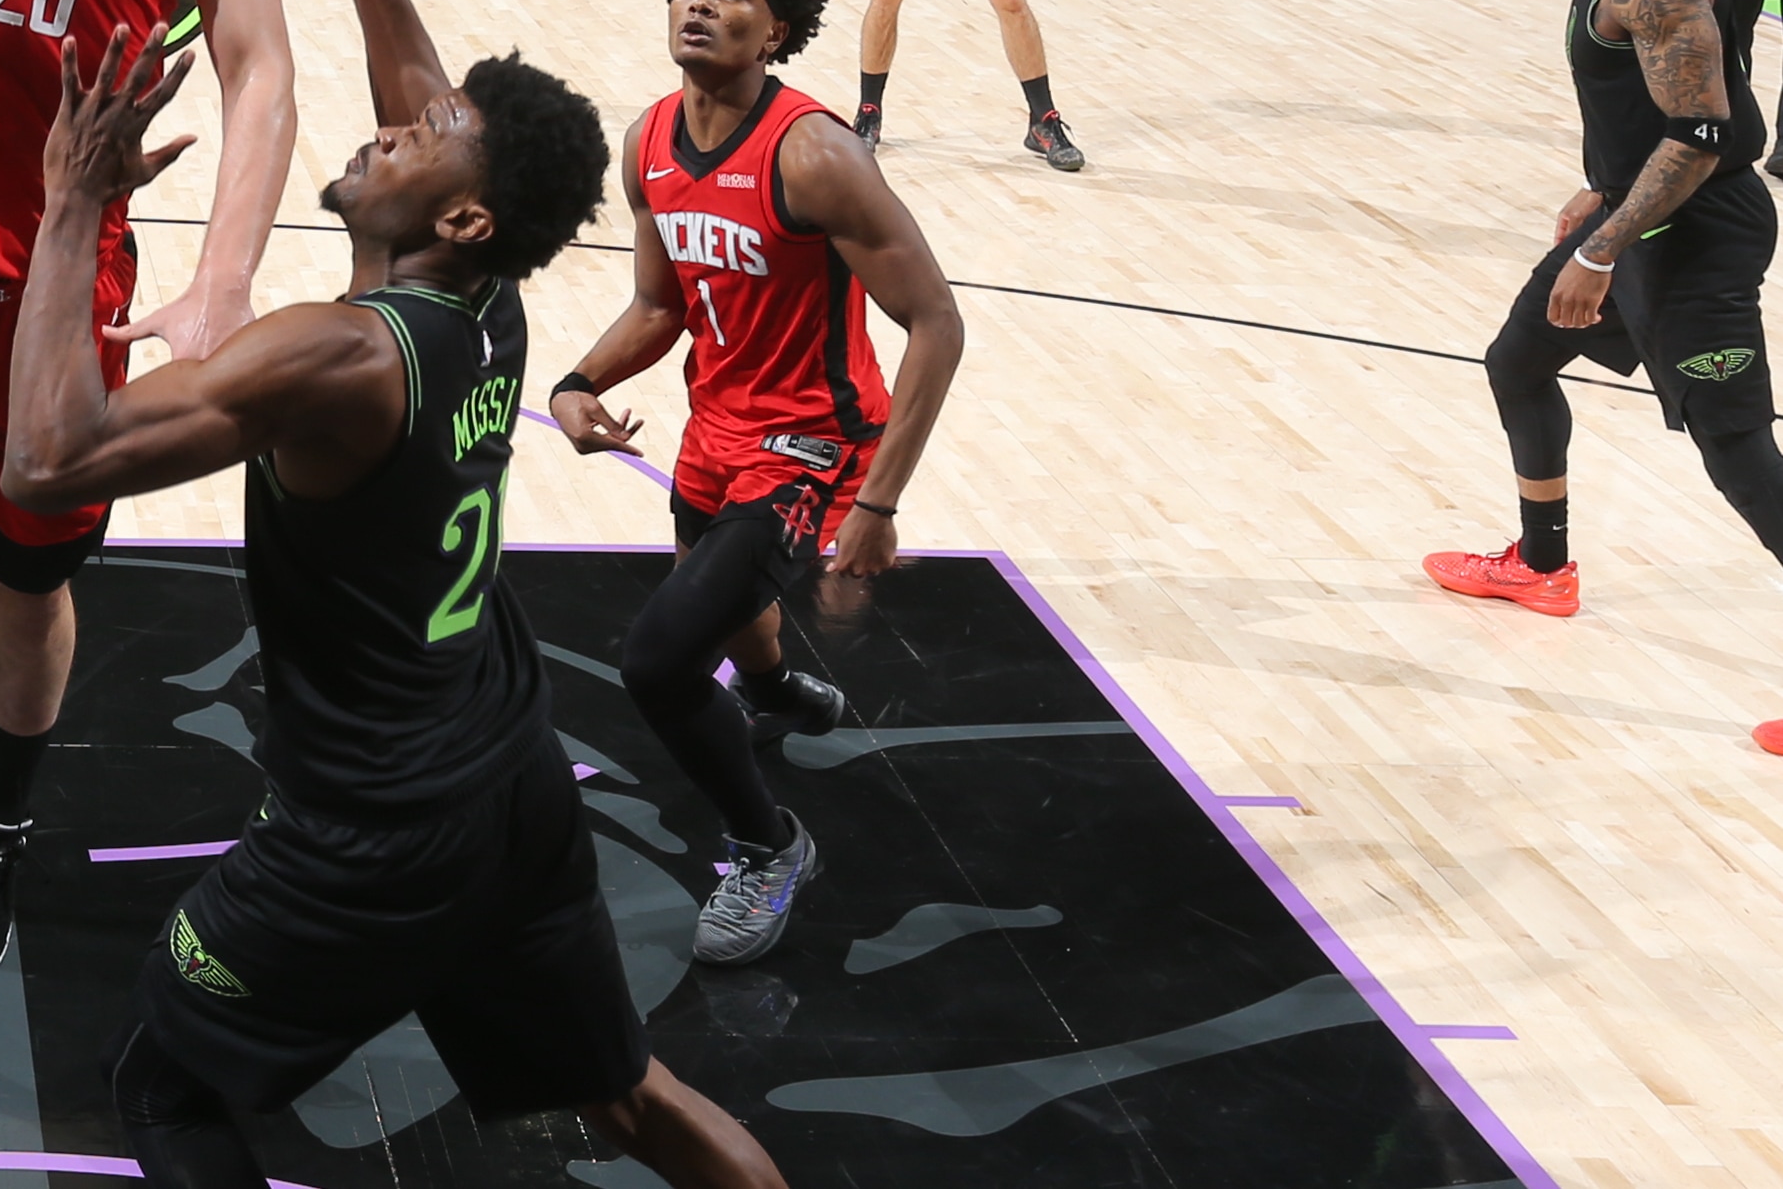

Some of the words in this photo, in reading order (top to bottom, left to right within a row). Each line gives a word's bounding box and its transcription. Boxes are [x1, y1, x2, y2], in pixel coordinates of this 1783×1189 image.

[652, 211, 769, 276] OCKETS
[697, 279, 726, 347] 1
[452, 376, 518, 462] MISSI
[427, 487, 492, 643] 2
